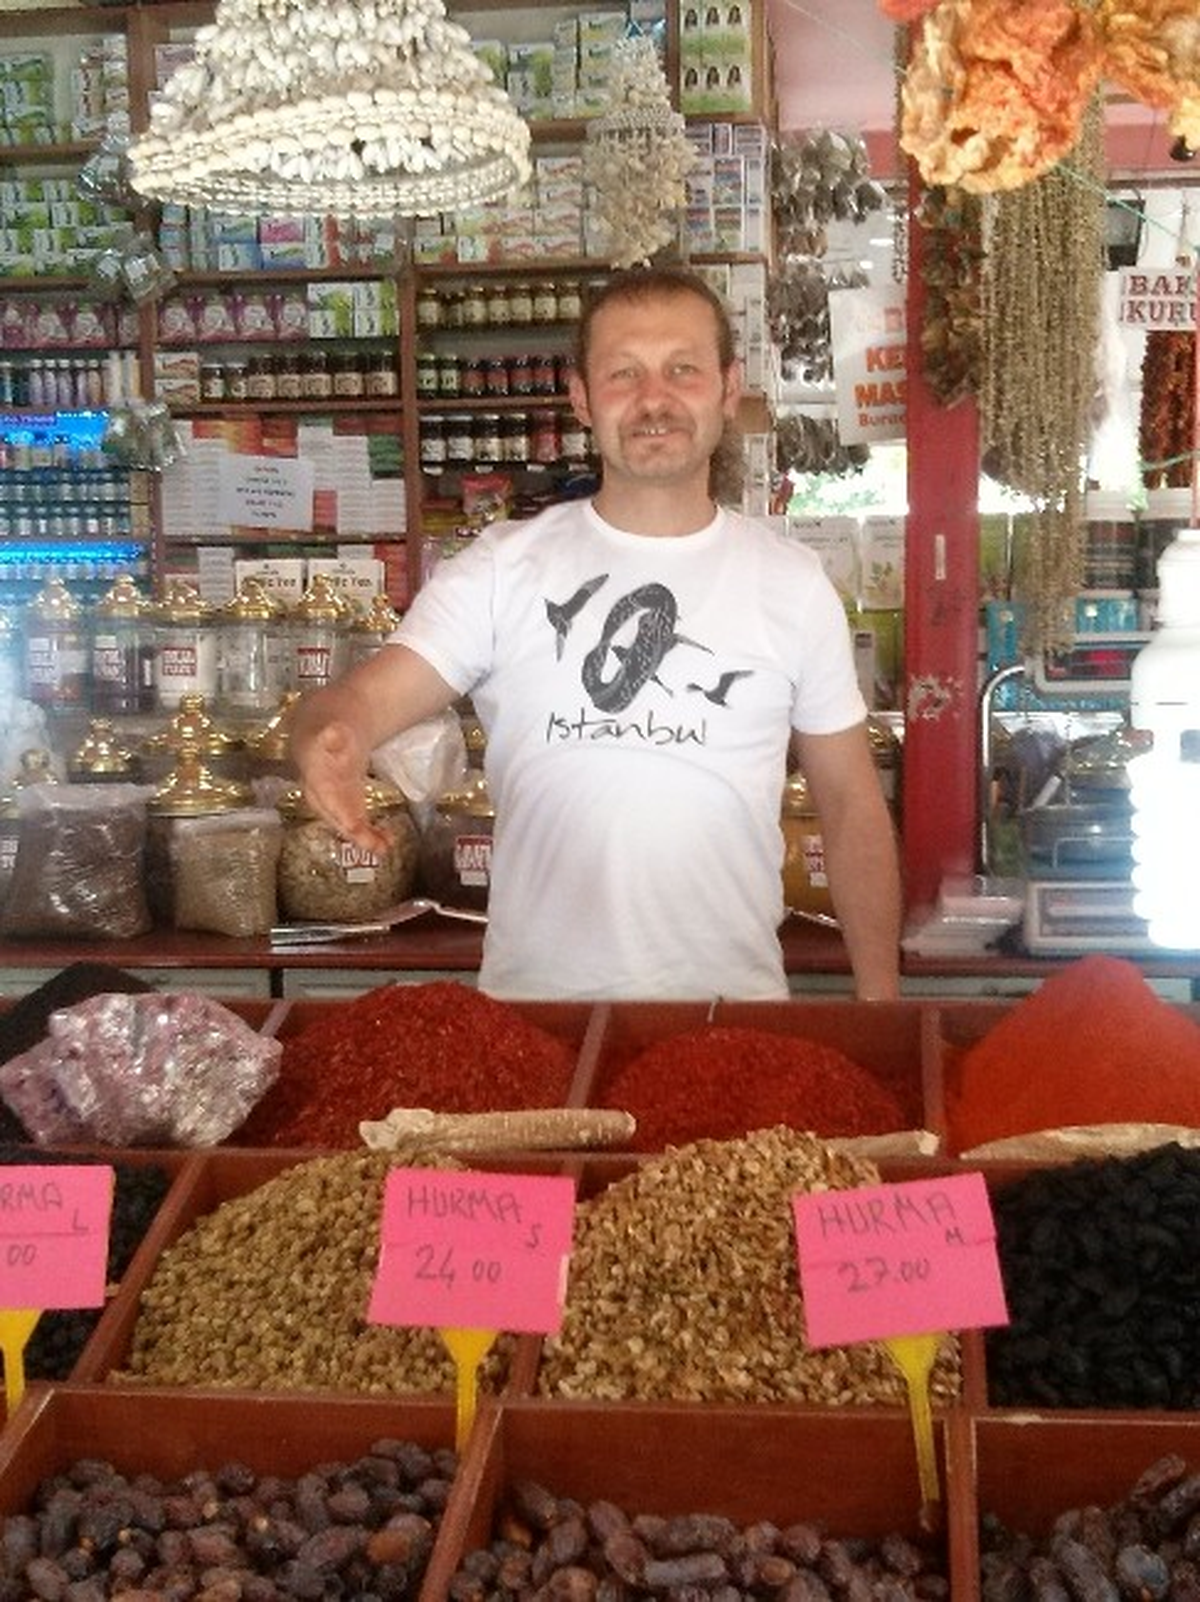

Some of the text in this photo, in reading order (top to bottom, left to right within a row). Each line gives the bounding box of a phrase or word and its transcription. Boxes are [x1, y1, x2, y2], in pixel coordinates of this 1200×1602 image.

[408, 1186, 522, 1224] HURMA
[817, 1191, 956, 1238] HURMA
[415, 1244, 455, 1290] 24
